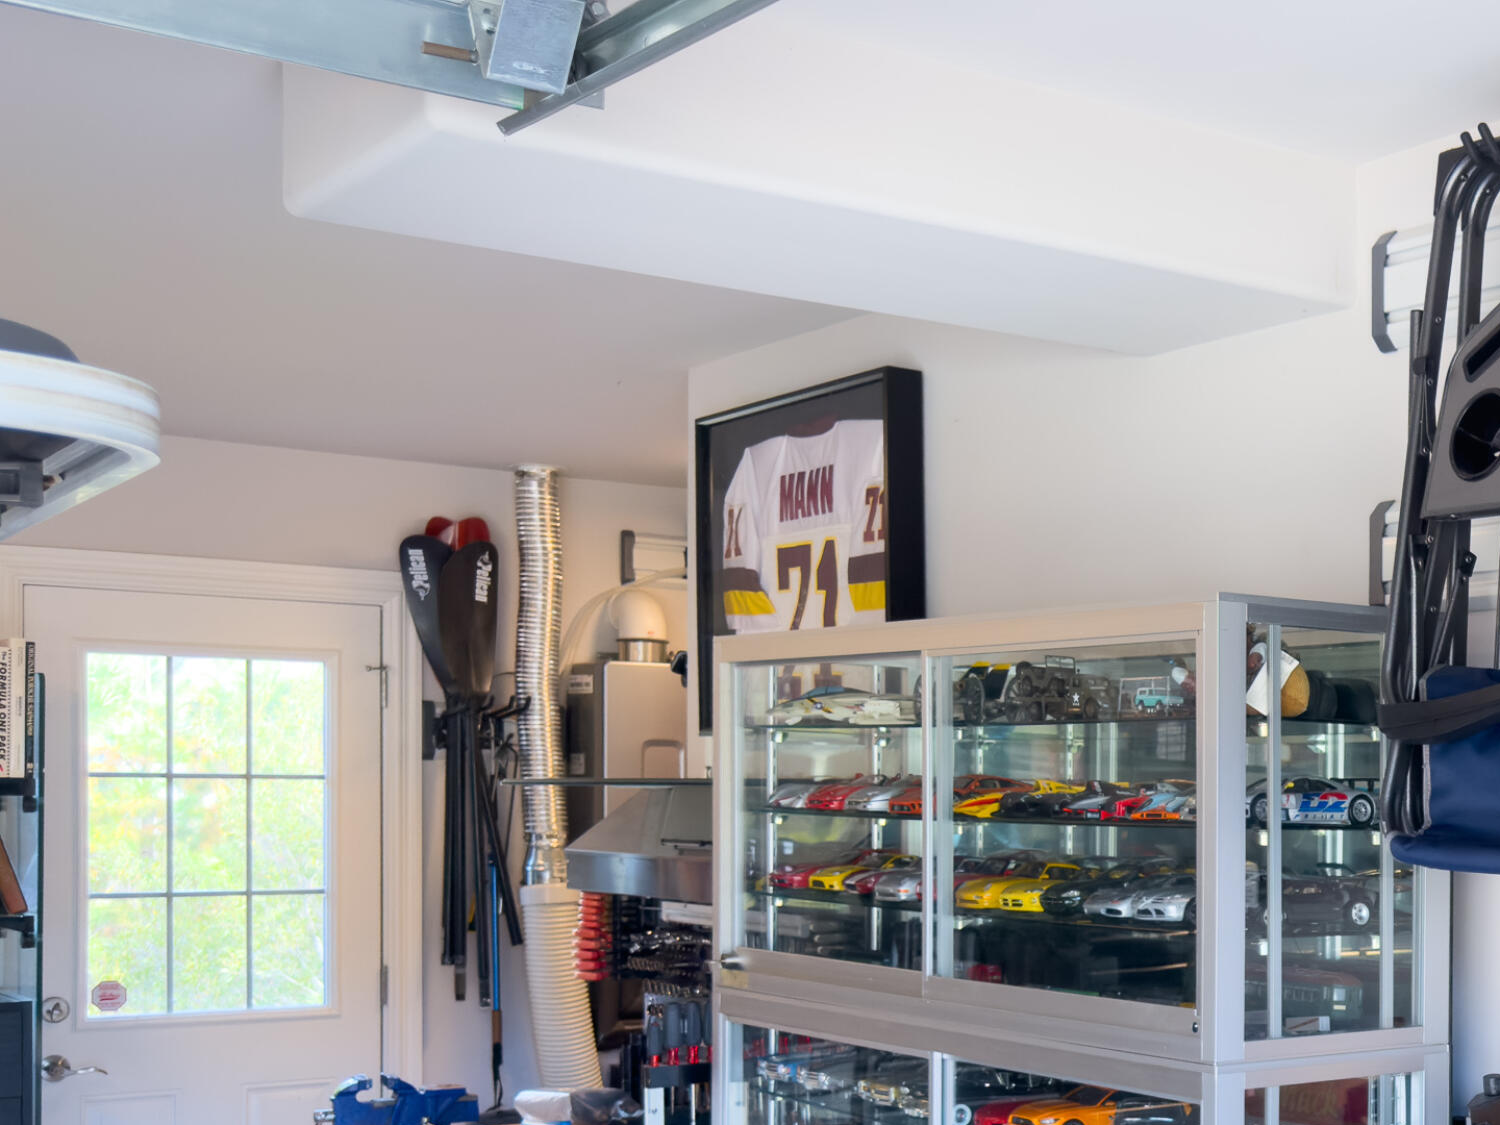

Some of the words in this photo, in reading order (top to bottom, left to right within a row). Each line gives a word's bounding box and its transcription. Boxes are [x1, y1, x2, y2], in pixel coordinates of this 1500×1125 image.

[779, 464, 834, 522] MANN
[408, 547, 431, 600] Pelican
[475, 550, 493, 603] Pelican
[776, 537, 838, 631] 71
